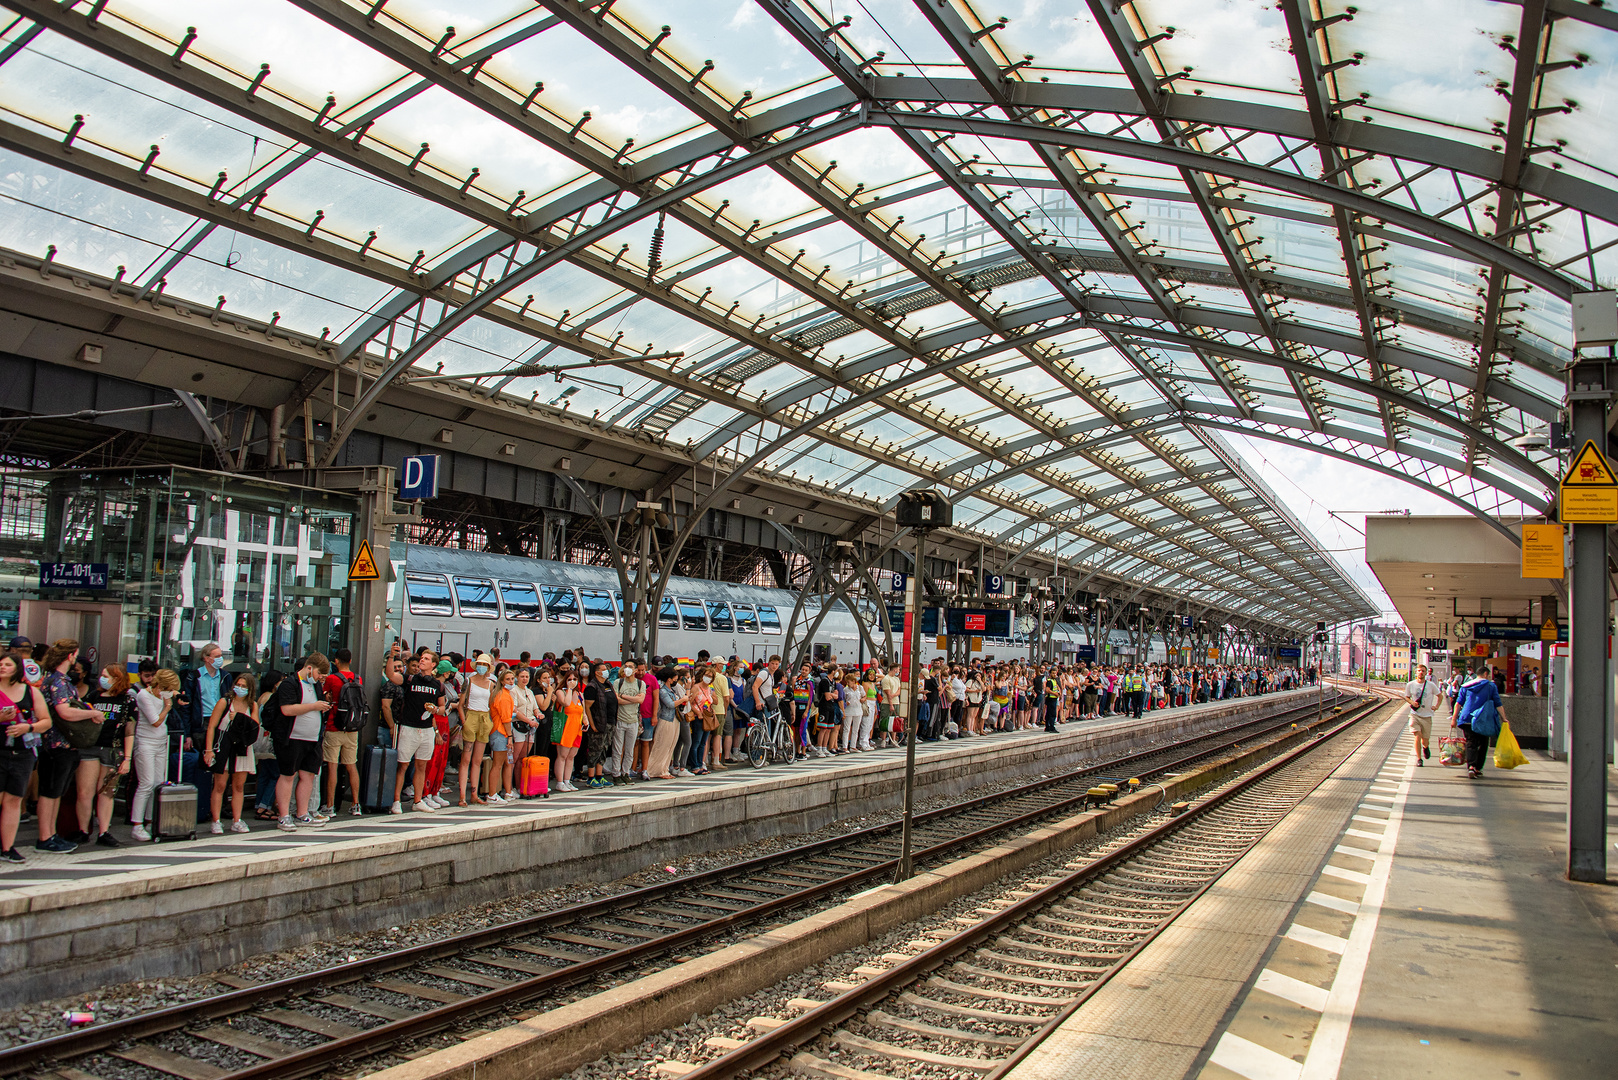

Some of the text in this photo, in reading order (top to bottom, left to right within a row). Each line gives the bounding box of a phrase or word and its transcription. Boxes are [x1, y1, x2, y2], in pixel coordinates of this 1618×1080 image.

[405, 458, 424, 489] D
[53, 563, 66, 577] 1-7
[73, 563, 92, 577] 10-11
[893, 573, 902, 588] 8
[991, 575, 1001, 590] 9
[1182, 616, 1189, 626] E
[1421, 638, 1446, 649] C 10
[411, 684, 438, 695] LIBERTY
[112, 704, 122, 713] BE
